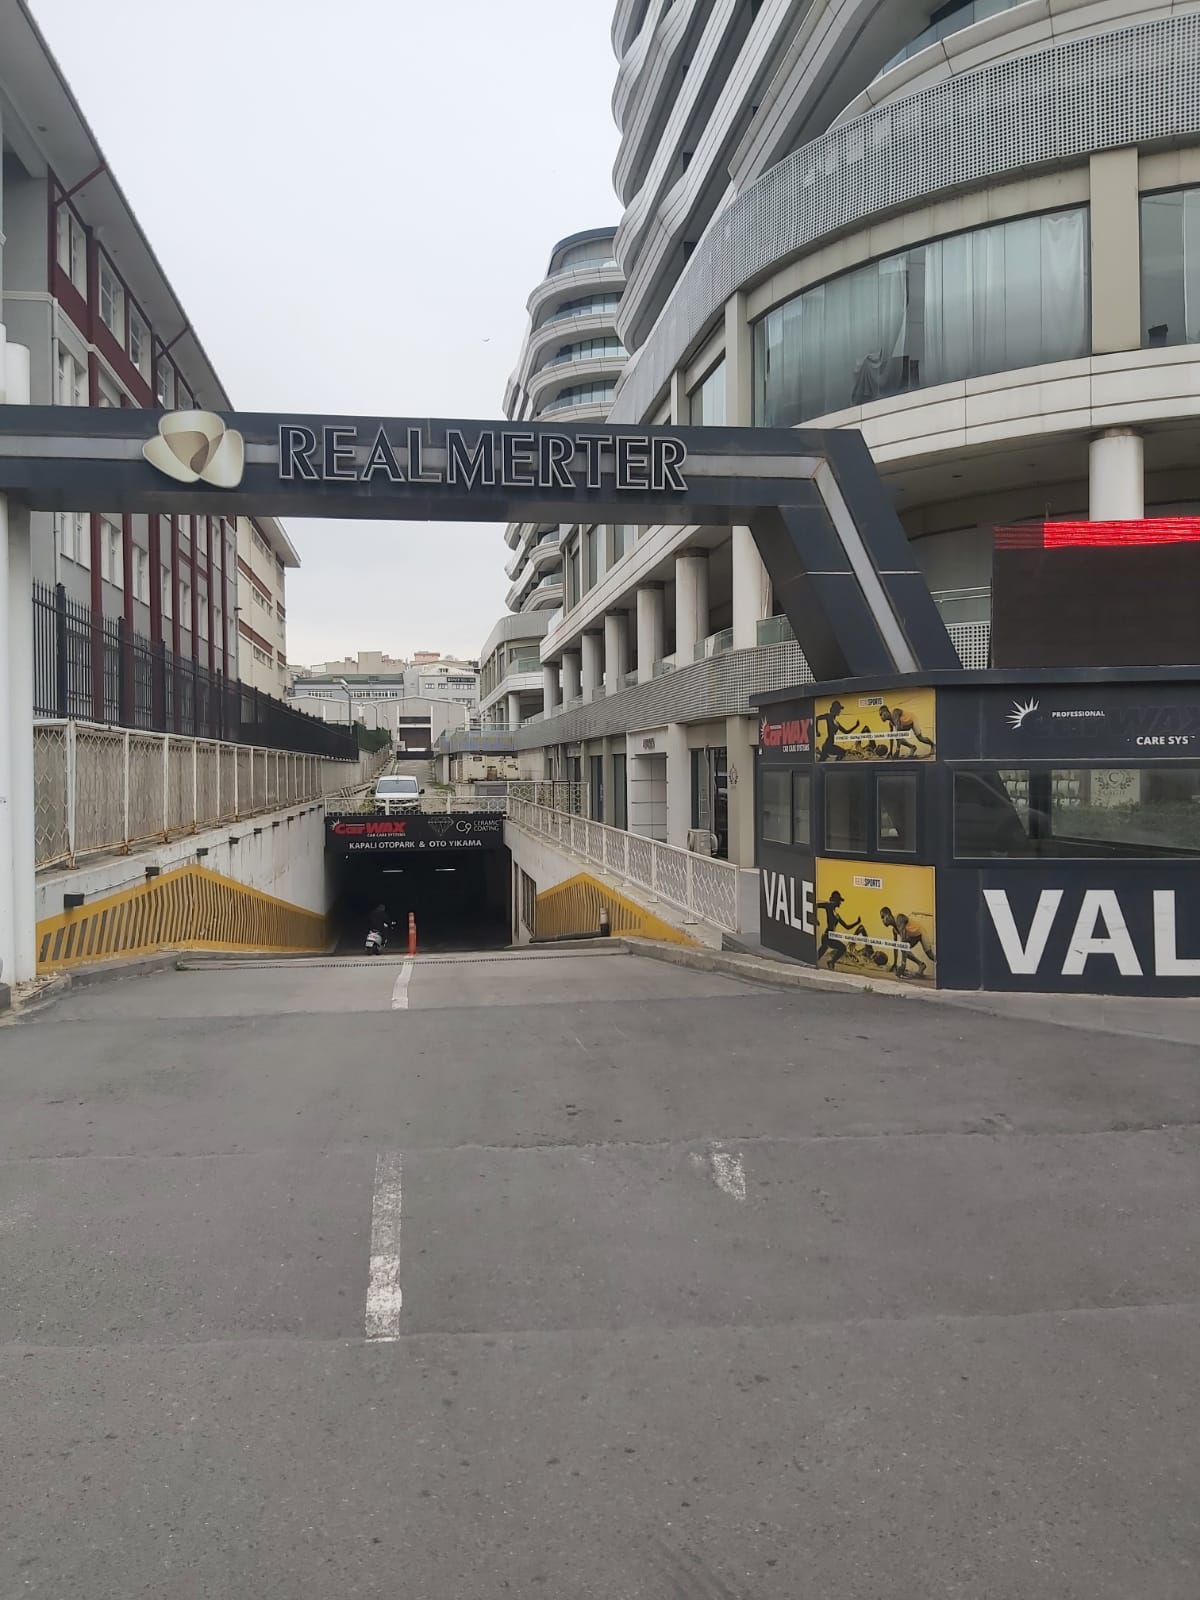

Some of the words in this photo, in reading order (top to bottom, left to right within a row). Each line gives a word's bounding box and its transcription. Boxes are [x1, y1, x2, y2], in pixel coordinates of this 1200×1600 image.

[278, 421, 688, 492] REALMERTER
[1051, 710, 1105, 719] PROFESSIONAL
[1136, 736, 1166, 746] CARE
[455, 820, 472, 835] C9
[349, 841, 377, 849] KAPALI
[378, 841, 415, 849] OTOPARK
[418, 840, 426, 848] &
[429, 840, 447, 848] OTO
[448, 839, 482, 847] YIKAMA
[763, 869, 815, 936] VALE
